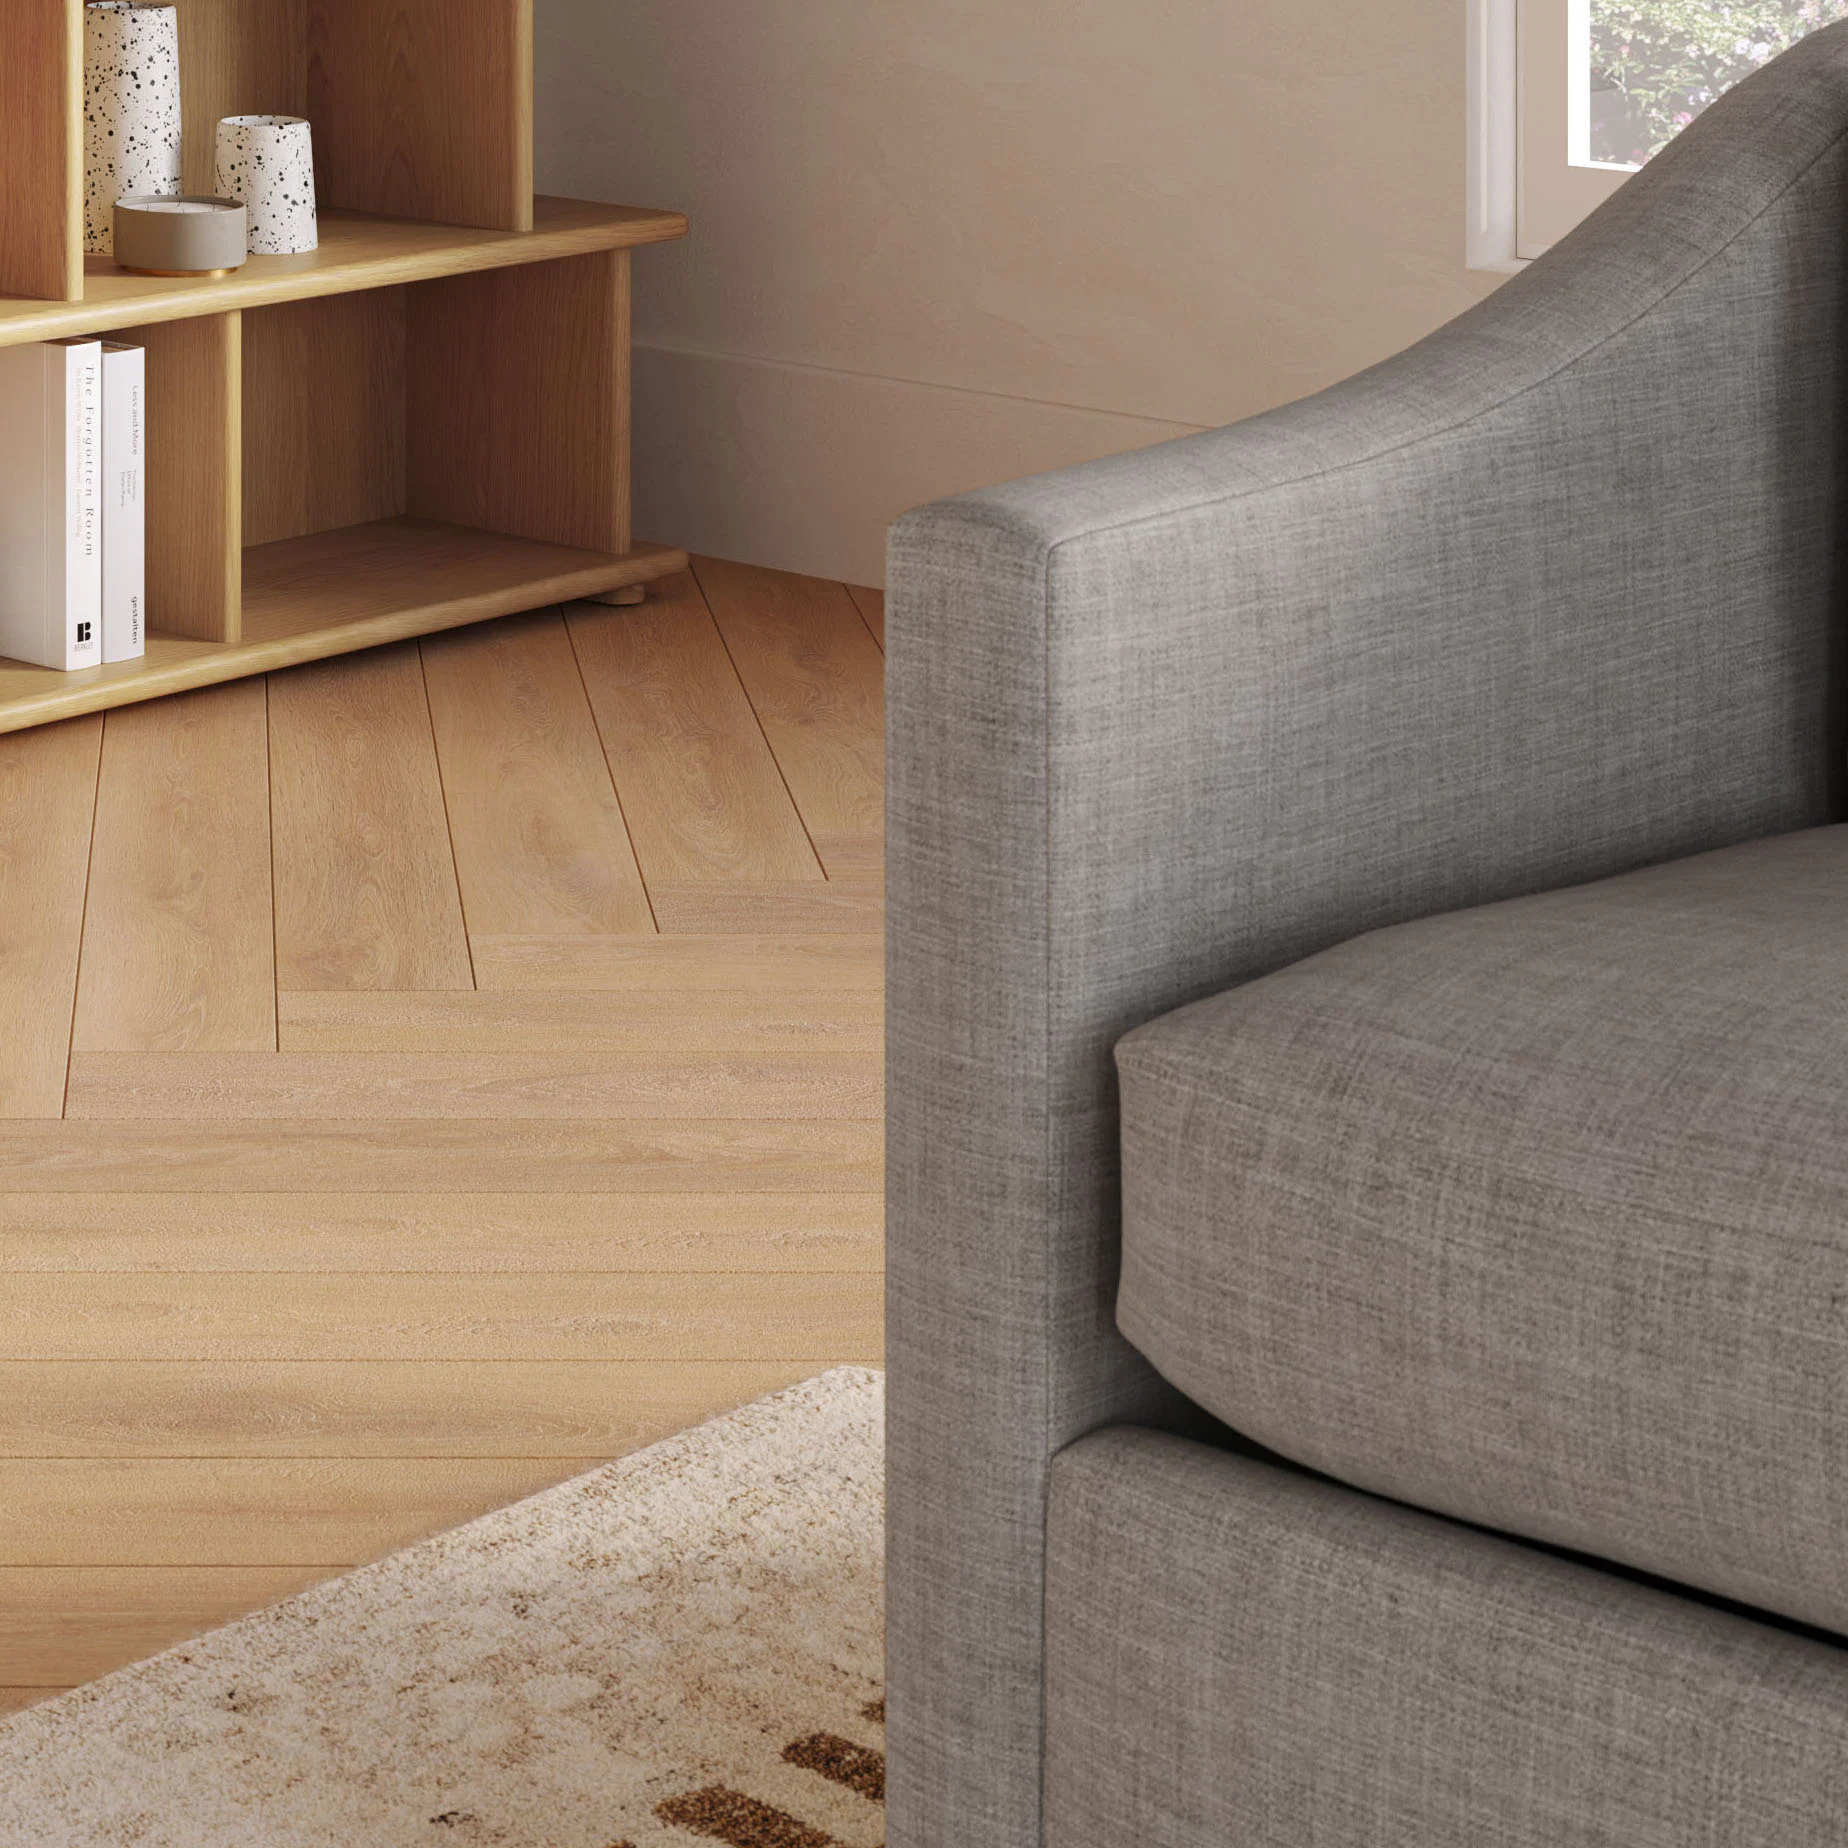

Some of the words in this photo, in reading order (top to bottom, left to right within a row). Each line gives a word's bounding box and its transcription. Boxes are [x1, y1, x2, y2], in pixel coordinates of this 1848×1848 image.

[85, 364, 94, 396] The
[83, 406, 94, 496] Forgotten
[85, 508, 94, 556] Room
[130, 596, 138, 644] gestalten
